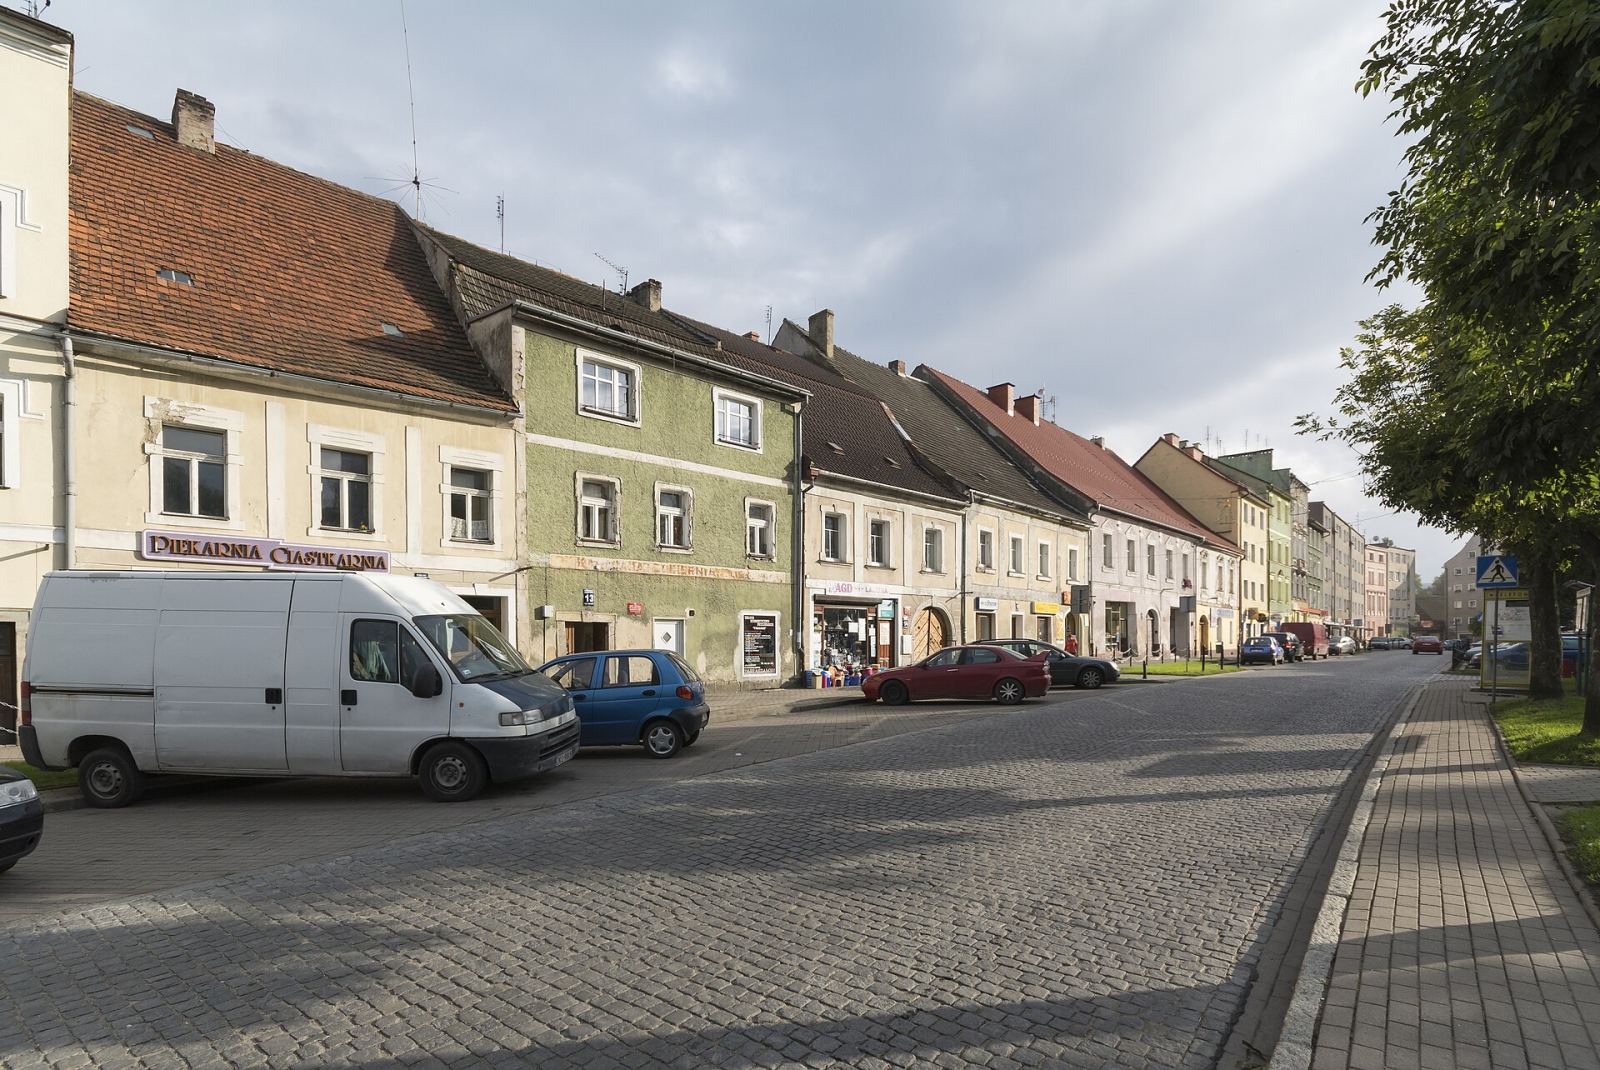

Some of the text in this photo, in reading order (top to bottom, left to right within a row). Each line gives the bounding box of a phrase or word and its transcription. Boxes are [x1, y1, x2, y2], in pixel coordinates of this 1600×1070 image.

[150, 535, 388, 570] PIEKARNIA CIASTKARNIA
[835, 582, 853, 593] AGD
[584, 594, 594, 603] 13
